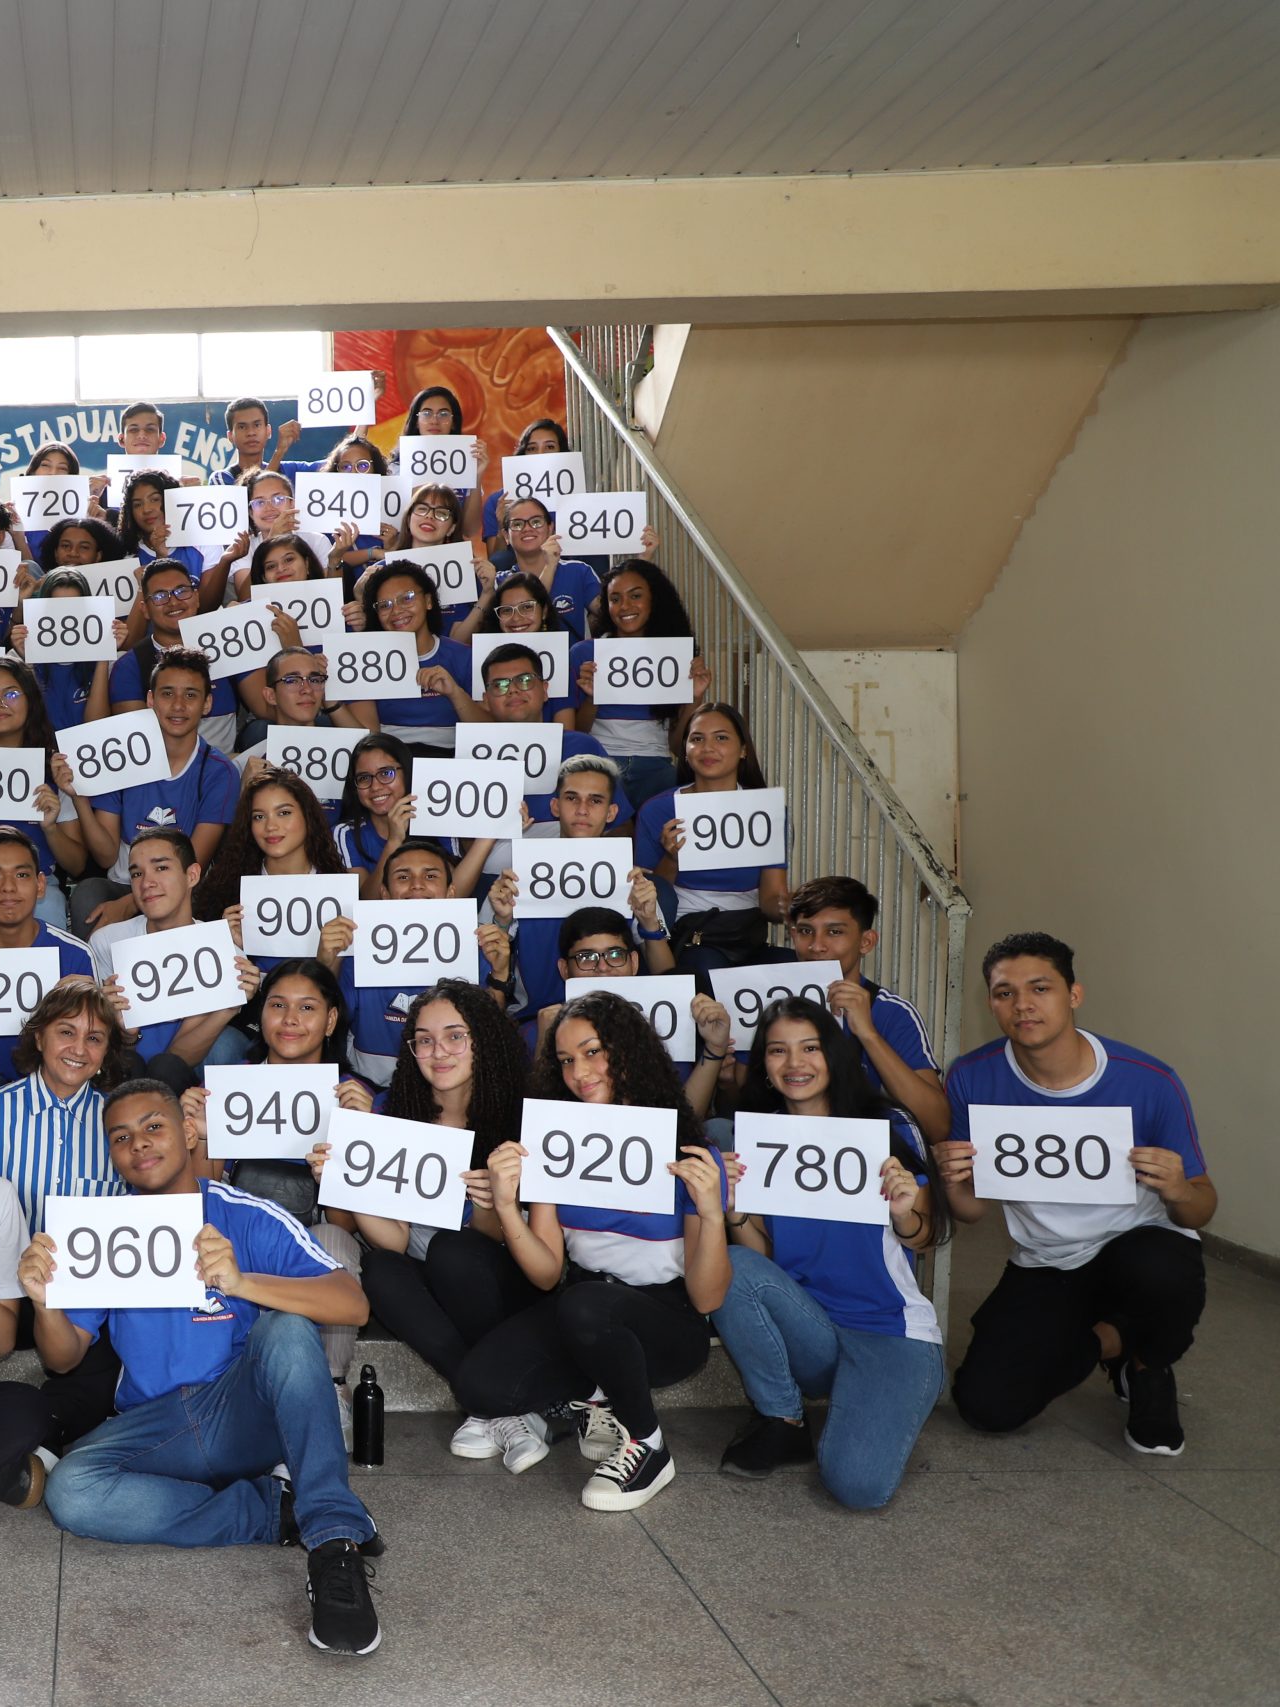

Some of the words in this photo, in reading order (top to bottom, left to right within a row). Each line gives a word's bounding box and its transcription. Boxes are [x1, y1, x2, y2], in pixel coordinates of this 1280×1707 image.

[308, 387, 365, 413] 800
[411, 450, 466, 475] 860
[515, 469, 574, 497] 840
[22, 490, 79, 517] 720
[177, 502, 238, 530] 760
[307, 490, 369, 519] 840
[568, 510, 634, 539] 840
[37, 615, 103, 646] 880
[198, 620, 266, 664] 880
[338, 650, 407, 683] 880
[608, 657, 680, 688] 860
[76, 732, 151, 778] 860
[281, 746, 353, 781] 880
[427, 780, 508, 818] 900
[693, 812, 772, 851] 900
[530, 861, 616, 899] 860
[257, 896, 342, 936] 900
[371, 923, 461, 964] 920
[131, 947, 222, 1001] 920
[225, 1091, 321, 1136] 940
[343, 1140, 447, 1199] 940
[543, 1130, 653, 1185] 920
[756, 1142, 867, 1195] 780
[994, 1133, 1110, 1180] 880
[67, 1225, 181, 1279] 960
